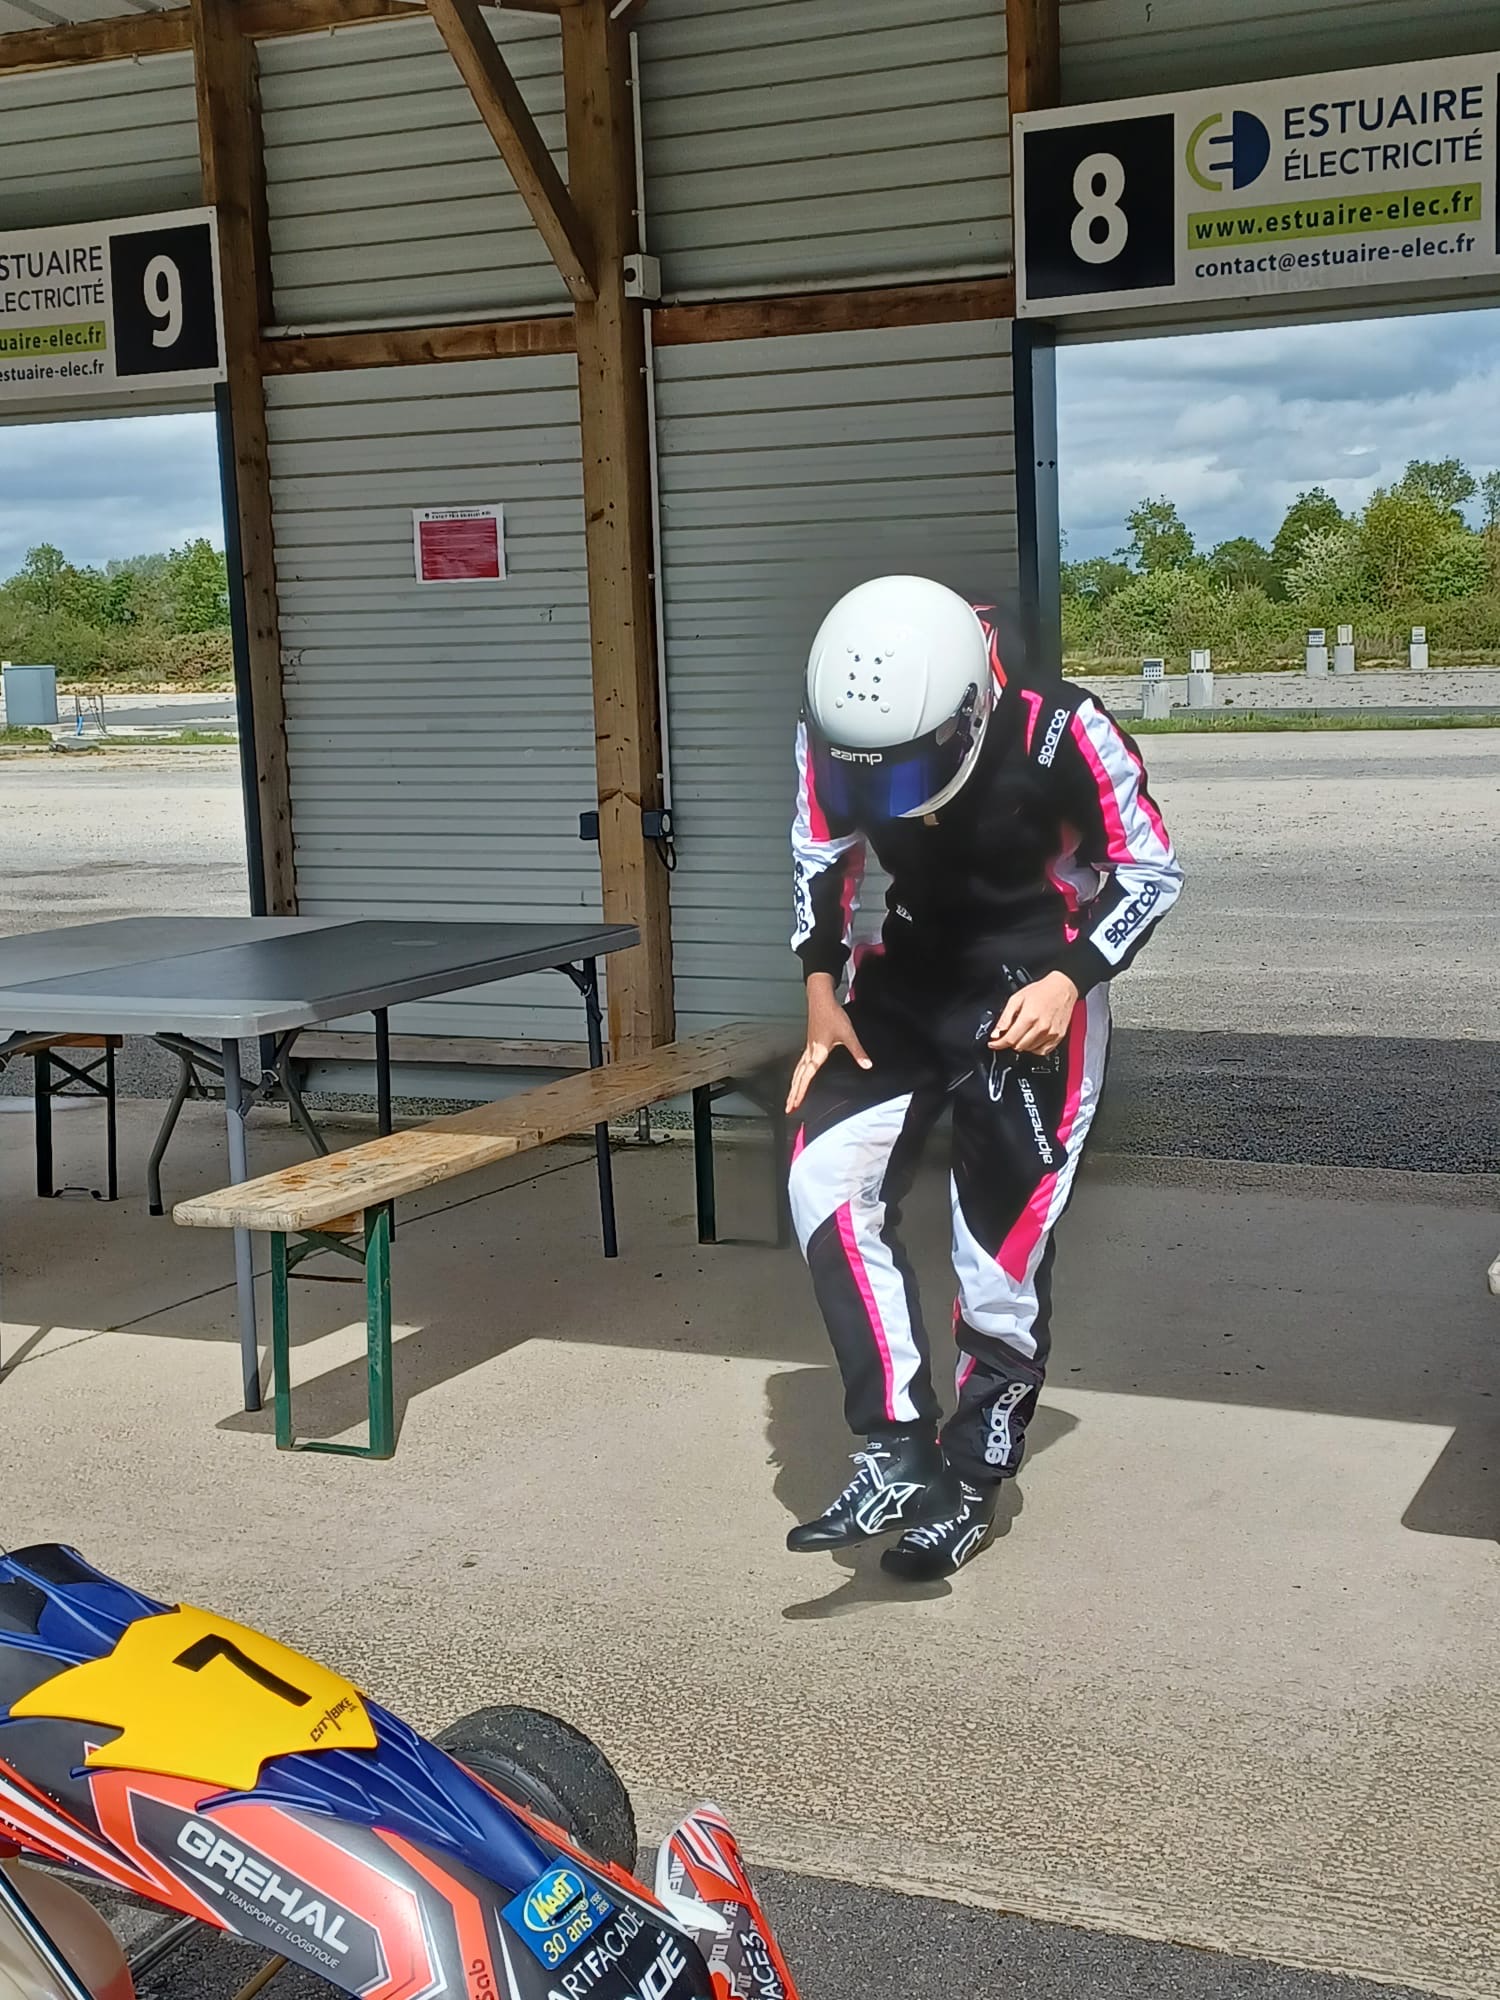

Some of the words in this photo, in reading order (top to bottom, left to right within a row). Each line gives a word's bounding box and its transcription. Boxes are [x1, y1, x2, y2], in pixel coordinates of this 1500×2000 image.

[1284, 85, 1483, 140] ESTUAIRE
[1284, 128, 1482, 181] ÉLECTRICITÉ
[1070, 152, 1129, 265] 8
[1195, 191, 1473, 239] www.estuaire-elec.fr
[1194, 233, 1475, 278] contact@estuaire-elec.fr
[143, 254, 183, 348] 9
[830, 747, 883, 766] zamp
[1038, 708, 1069, 767] sparco
[1104, 880, 1158, 947] sparco
[1018, 1078, 1054, 1165] alpinestars
[984, 1382, 1030, 1466] sparco
[176, 1820, 350, 1955] GREHAL
[226, 1890, 277, 1928] TRANSPORT
[273, 1921, 288, 1935] ET
[285, 1929, 341, 1969] LOGISTIQUE
[543, 1932, 567, 1963] 30
[566, 1912, 593, 1942] ans
[740, 1930, 786, 2000] ACE3
